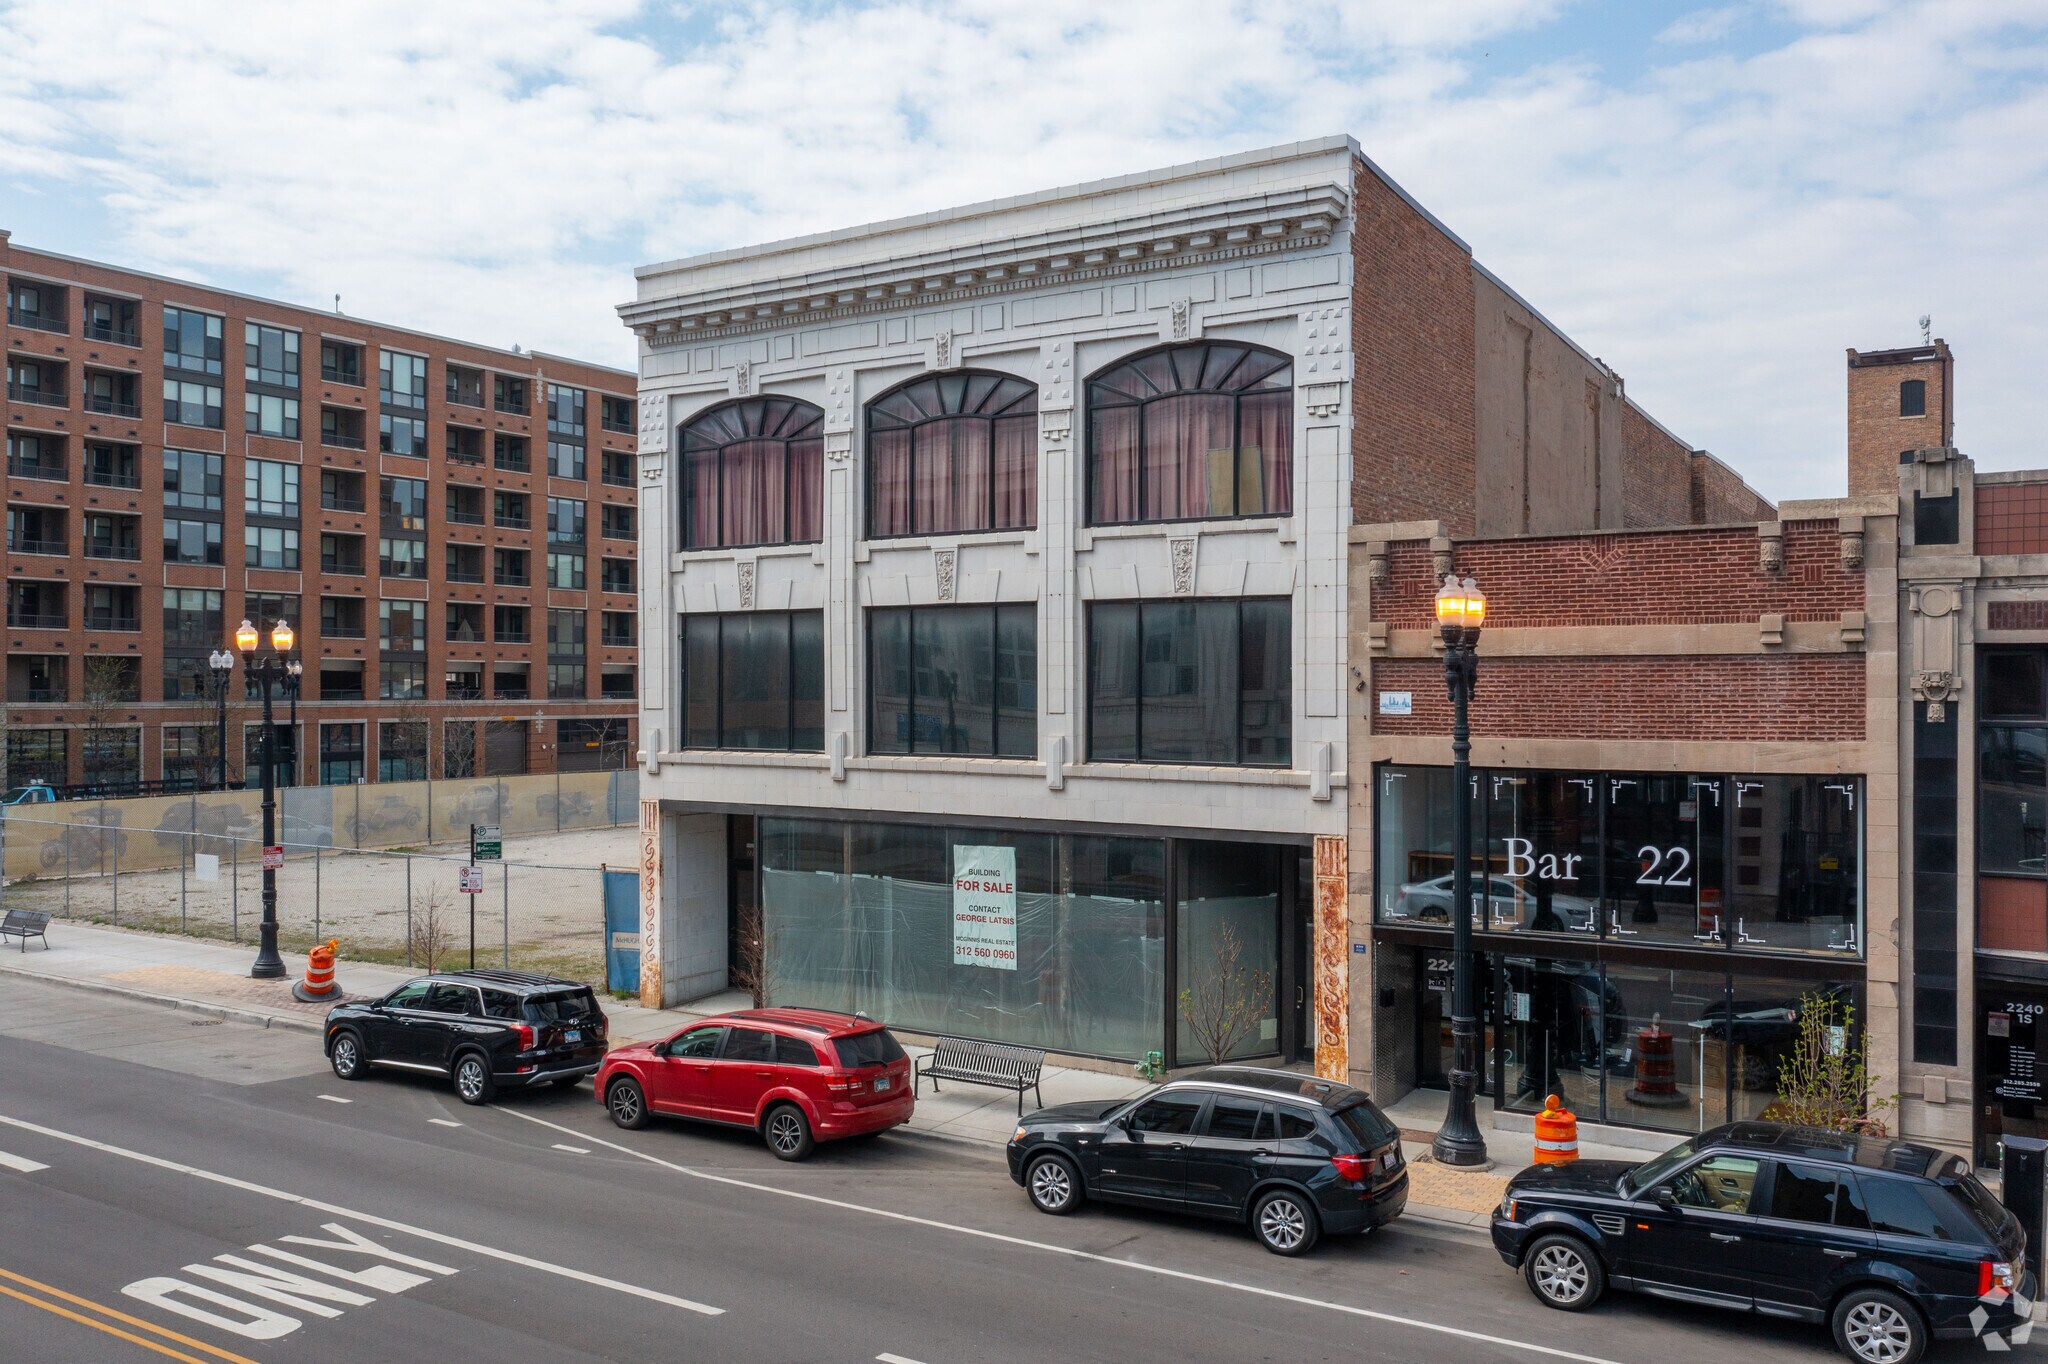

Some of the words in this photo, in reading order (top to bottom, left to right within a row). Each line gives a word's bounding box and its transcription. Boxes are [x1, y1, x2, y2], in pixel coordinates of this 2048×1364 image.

[1502, 837, 1582, 880] Bar
[1635, 845, 1692, 886] 22
[968, 868, 1001, 877] BUILDING
[956, 880, 980, 892] FOR
[983, 882, 1013, 894] SALE
[968, 905, 1001, 914] CONTACT
[955, 914, 987, 923] GEORGE
[989, 917, 1015, 925] LATSIS
[955, 945, 972, 956] 312
[974, 947, 991, 958] 560
[993, 949, 1015, 960] 0960
[2006, 1002, 2043, 1014] 2240
[2017, 1013, 2032, 1023] 1S
[120, 1222, 460, 1340] ONLY
